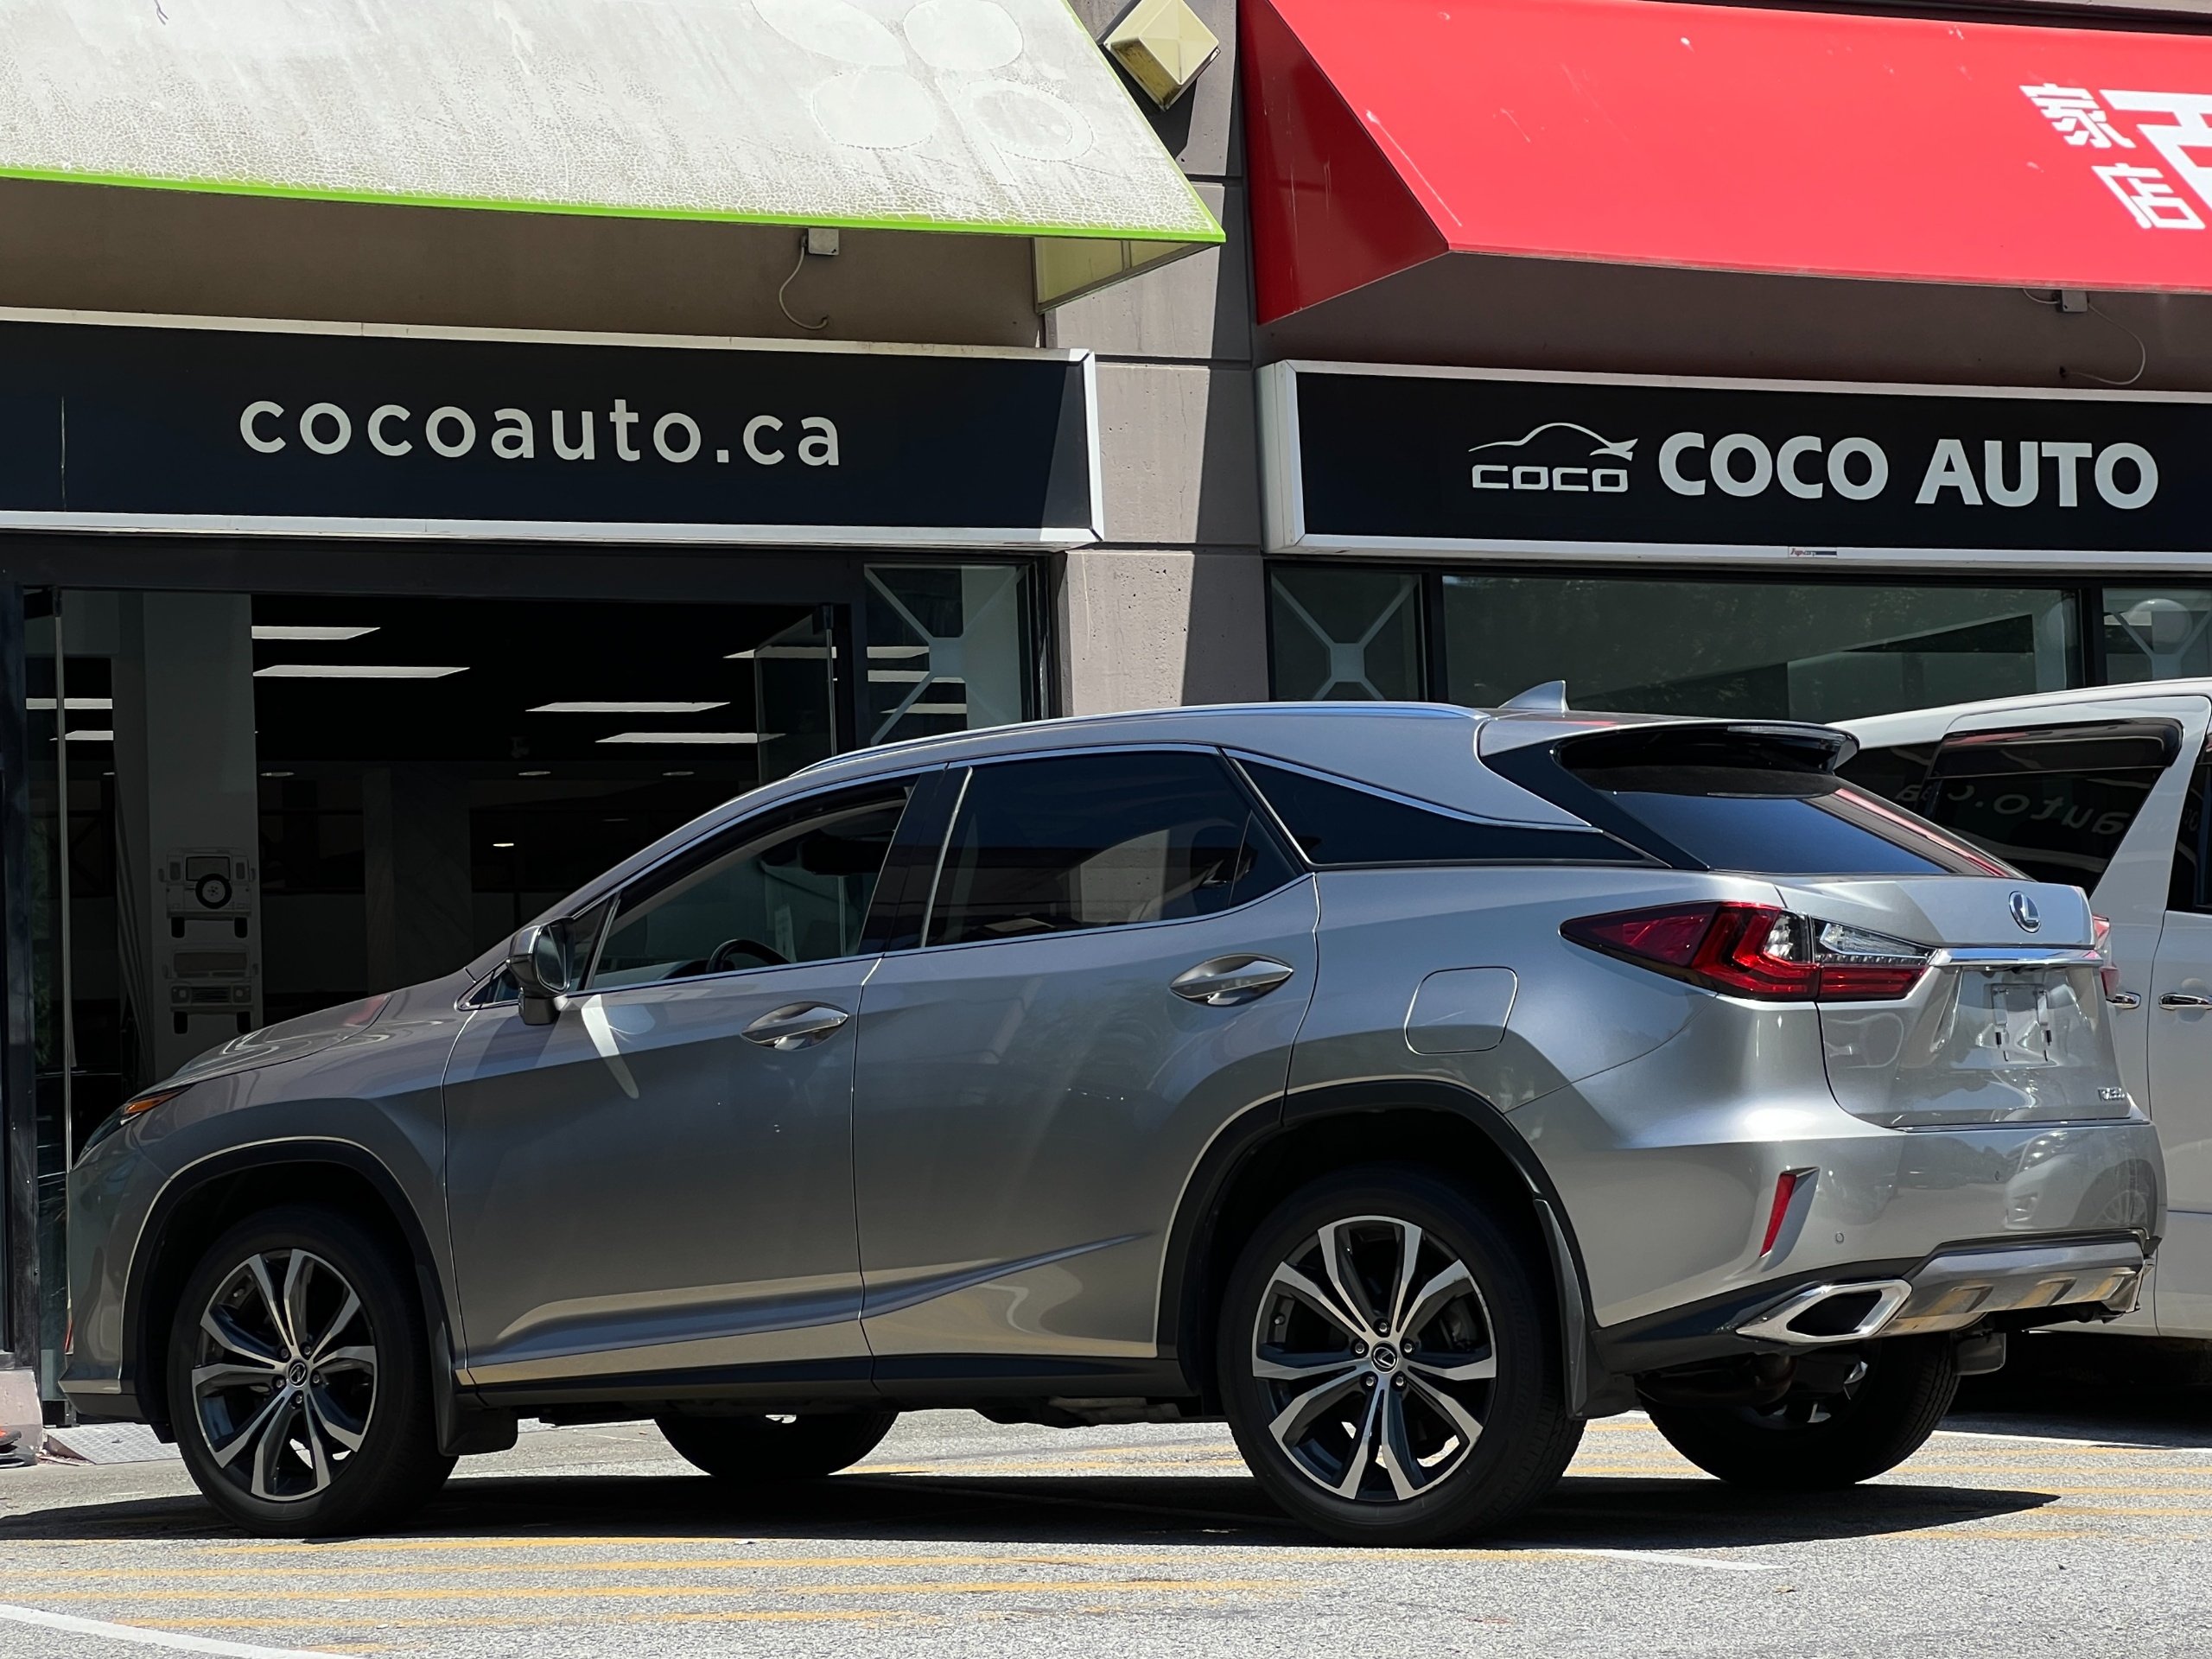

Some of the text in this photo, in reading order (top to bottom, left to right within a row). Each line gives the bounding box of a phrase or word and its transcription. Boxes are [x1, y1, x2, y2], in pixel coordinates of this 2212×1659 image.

[240, 398, 840, 467] cocoauto.ca
[1471, 464, 1629, 493] COCO
[1658, 431, 2159, 510] COCO AUTO
